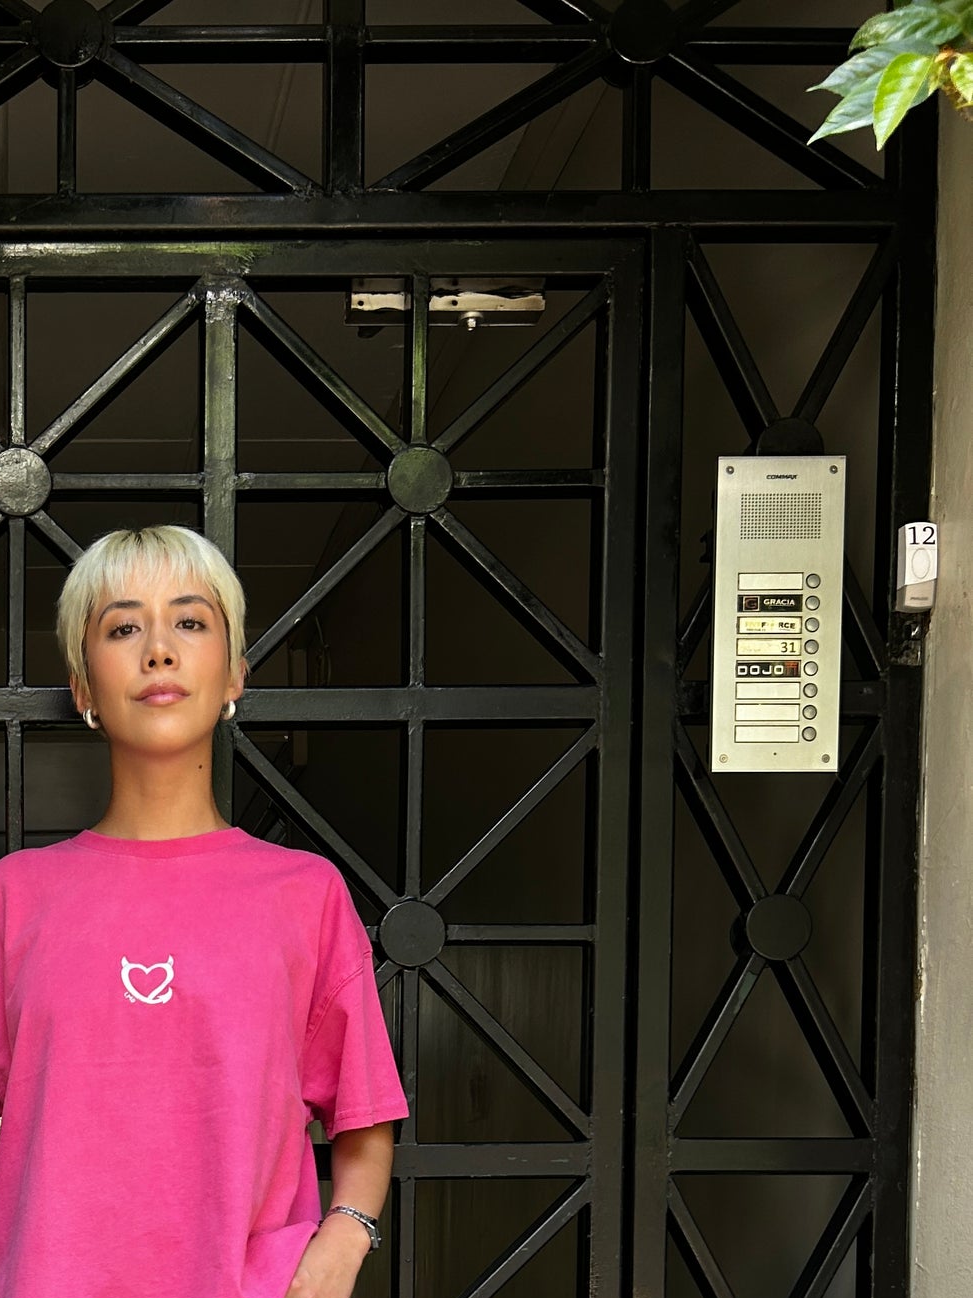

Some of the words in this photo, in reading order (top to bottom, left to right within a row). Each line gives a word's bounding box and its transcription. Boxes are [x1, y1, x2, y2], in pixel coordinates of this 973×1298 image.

[908, 526, 936, 545] 12
[780, 641, 796, 653] 31
[737, 665, 784, 675] DOJO
